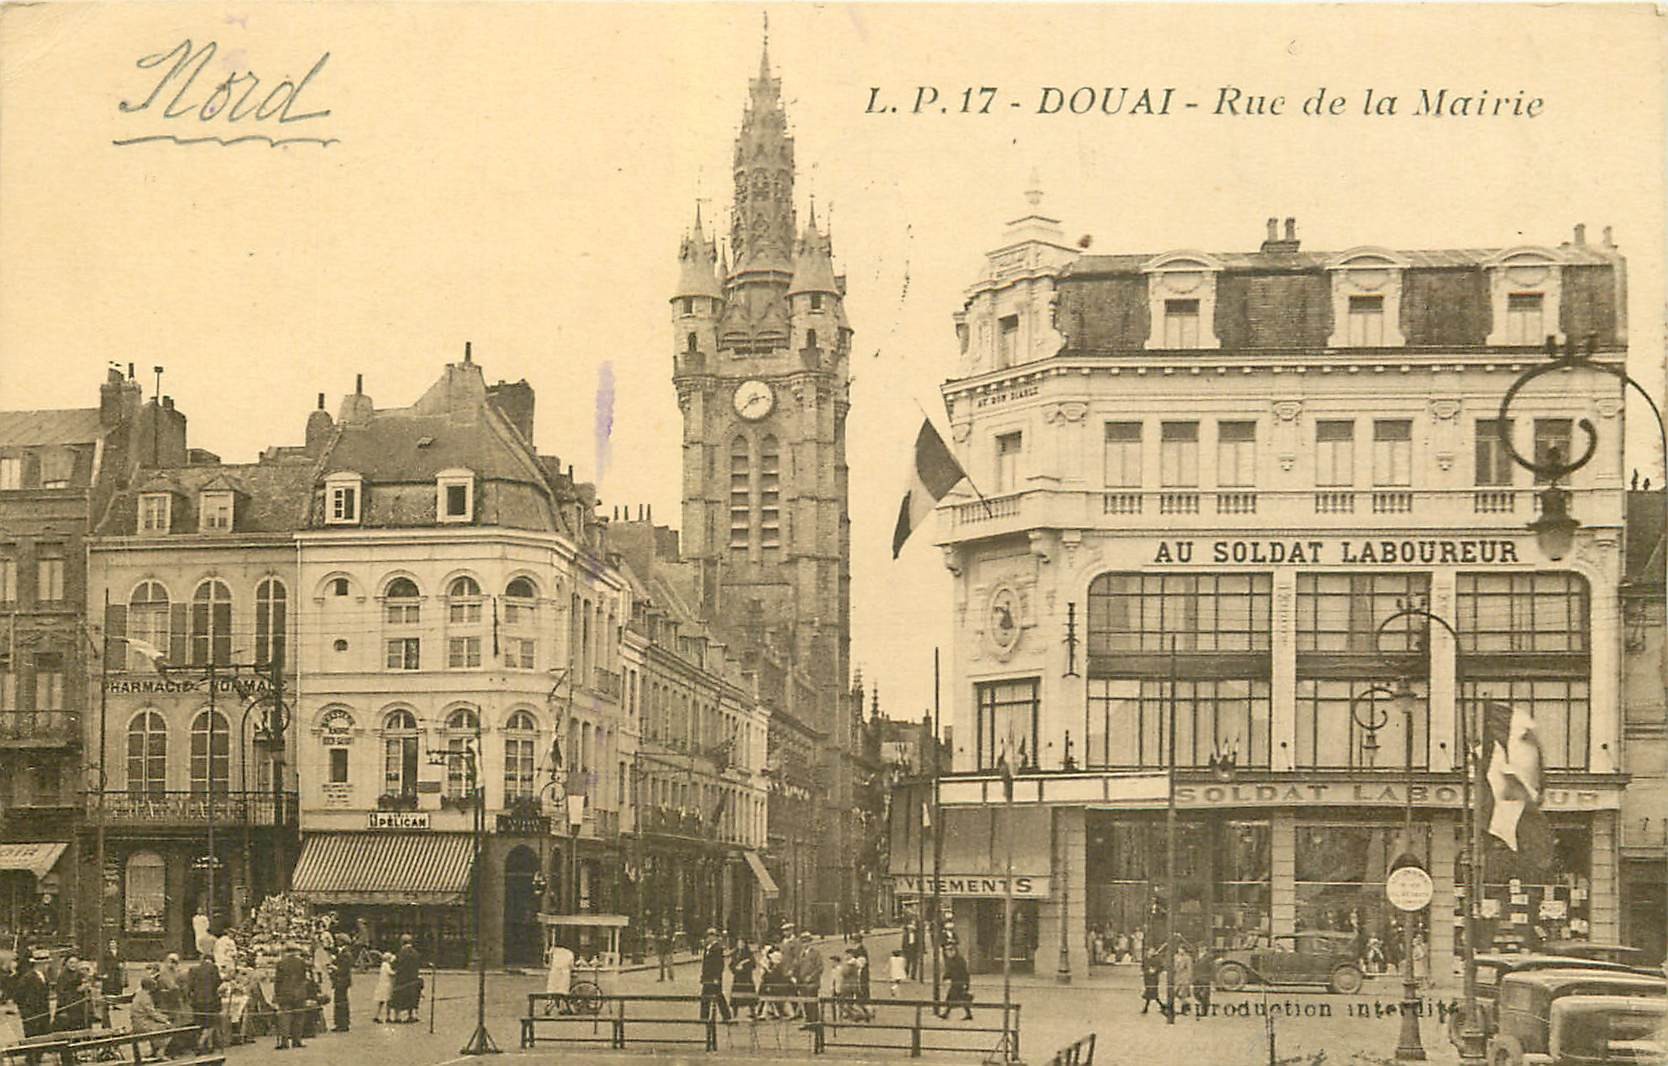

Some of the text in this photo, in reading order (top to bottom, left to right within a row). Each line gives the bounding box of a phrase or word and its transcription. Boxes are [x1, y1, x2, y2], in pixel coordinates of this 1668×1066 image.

[119, 38, 331, 123] Nord
[1154, 541, 1520, 563] AU SOLDAT LABOUREUR
[1176, 783, 1600, 806] SOLDAT LABOUR
